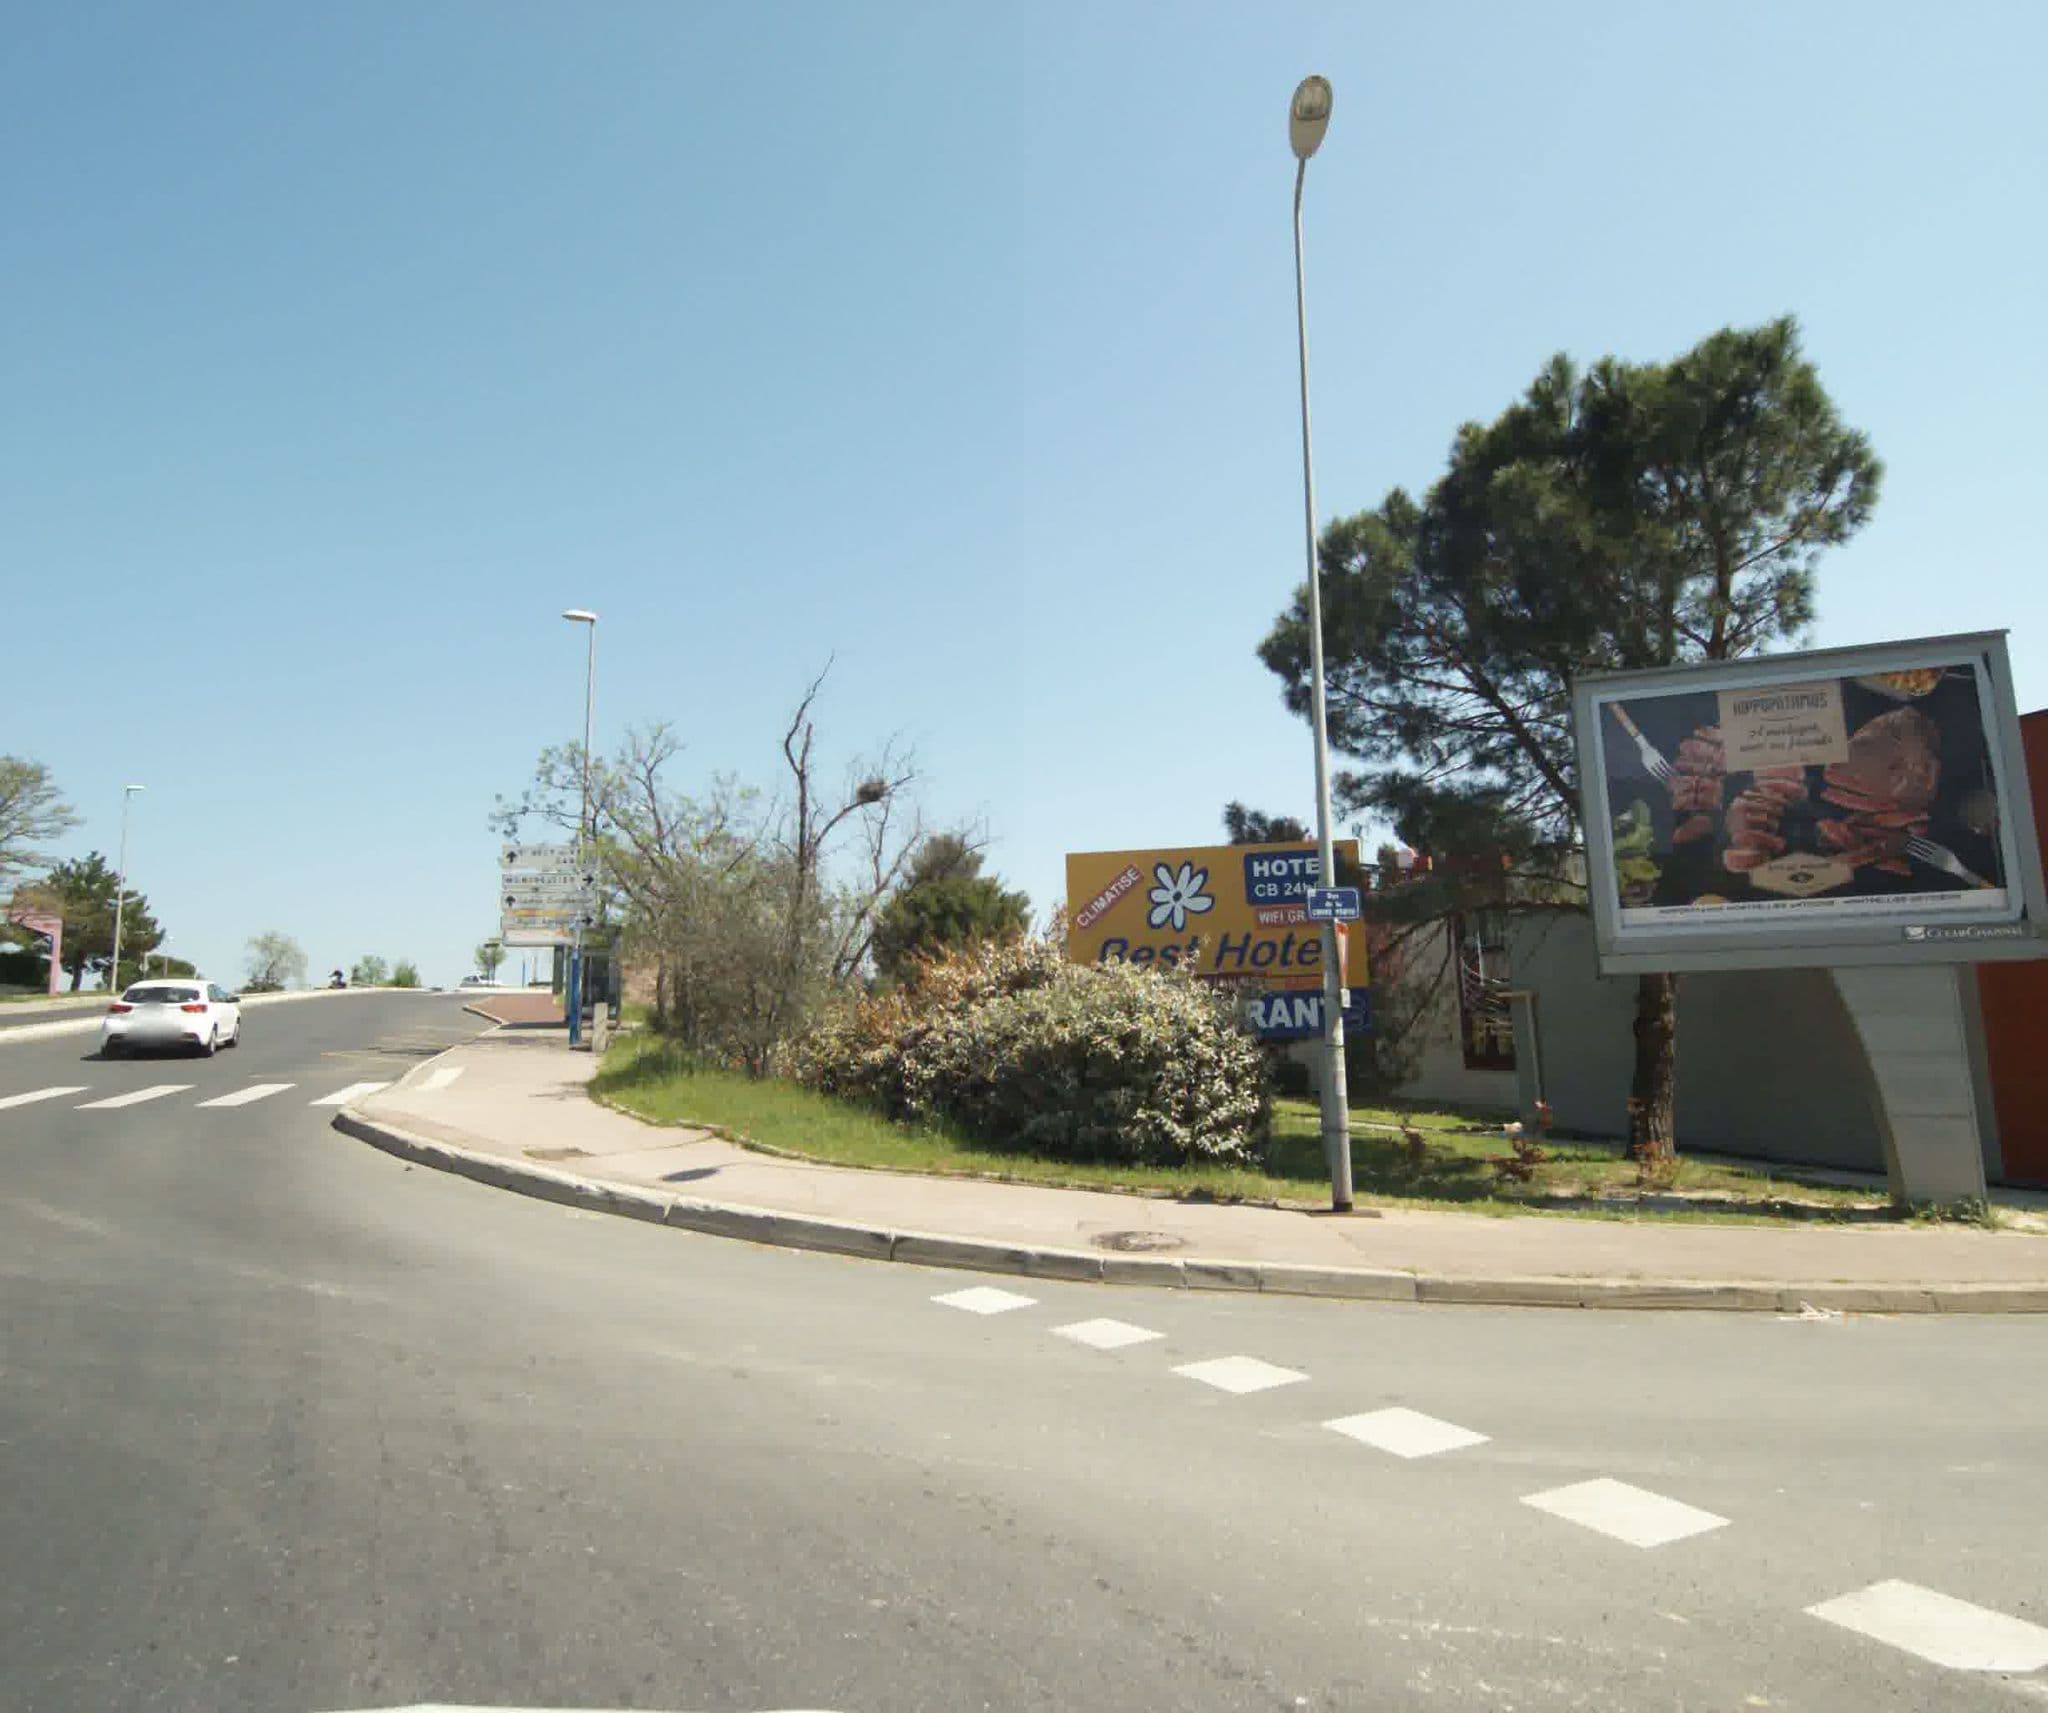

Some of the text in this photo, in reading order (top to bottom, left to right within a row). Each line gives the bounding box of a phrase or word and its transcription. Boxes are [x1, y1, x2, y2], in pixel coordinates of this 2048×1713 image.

[1253, 858, 1320, 877] HOTE
[1255, 883, 1279, 897] CB
[1215, 931, 1322, 968] Hote
